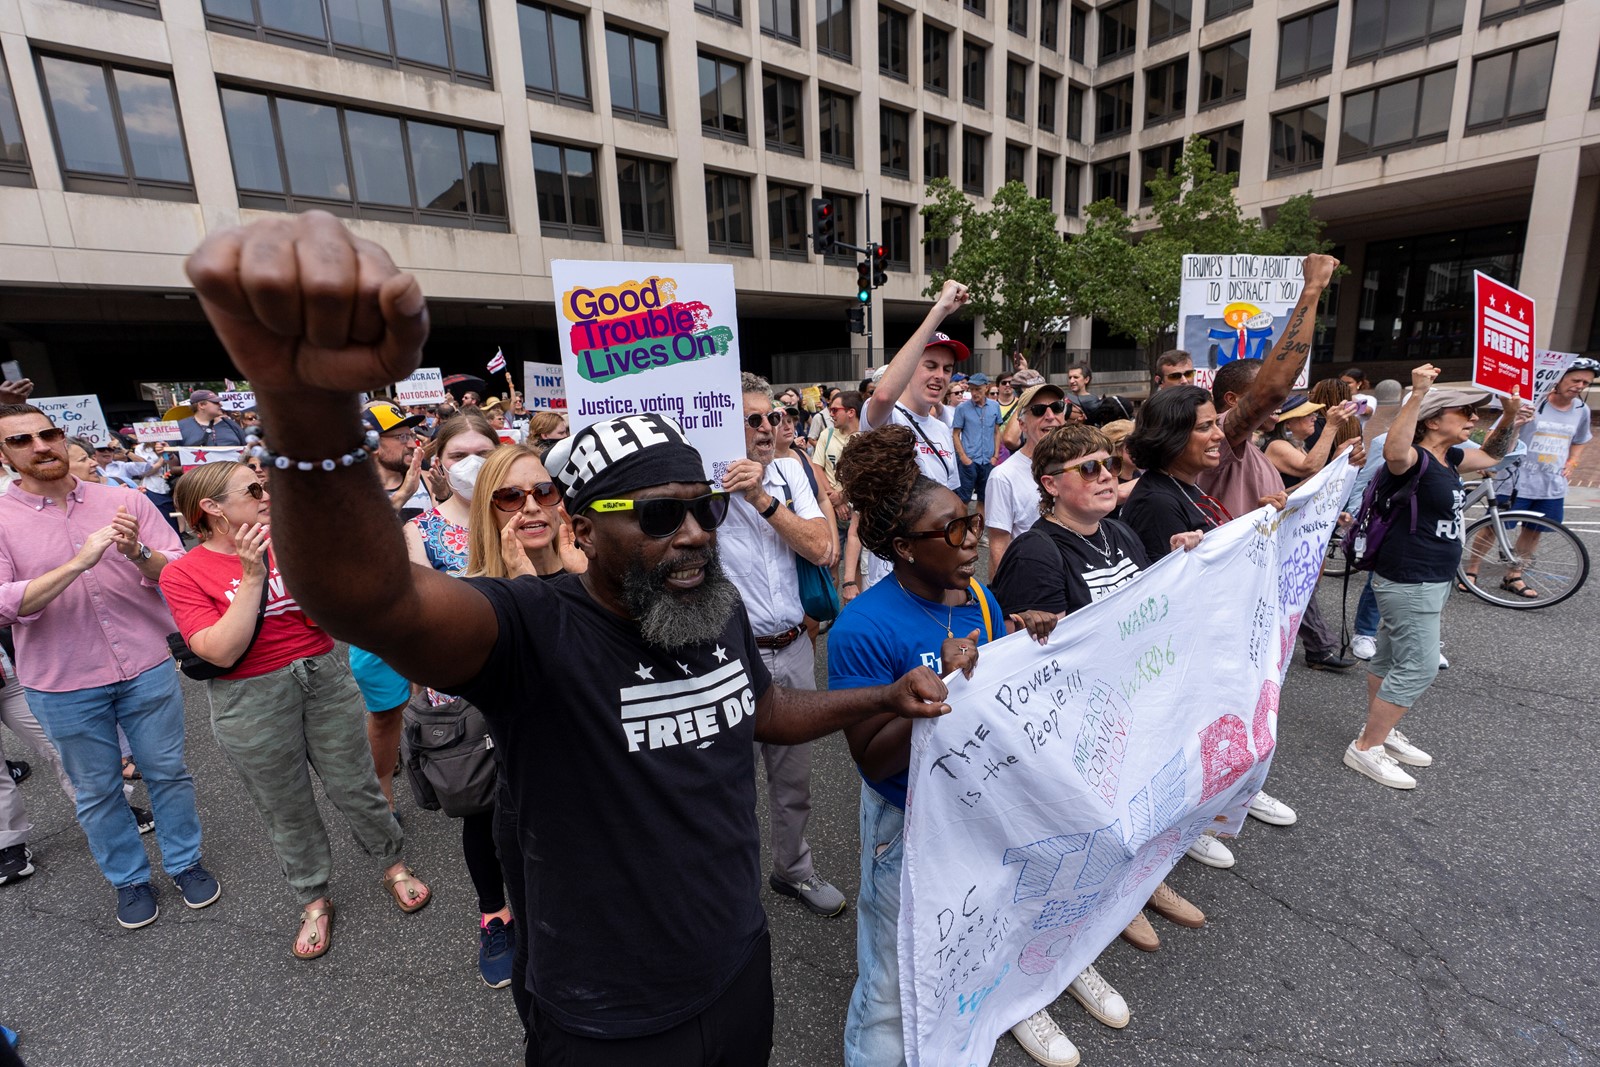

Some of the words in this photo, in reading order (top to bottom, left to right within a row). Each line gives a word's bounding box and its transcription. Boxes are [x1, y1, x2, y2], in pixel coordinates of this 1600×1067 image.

[1187, 256, 1223, 277] TRUMP'S
[1229, 256, 1259, 278] LYING
[1261, 258, 1290, 278] ABOUT
[570, 279, 661, 320] Good
[1209, 281, 1221, 302] TO
[1228, 281, 1271, 301] DISTRACT
[1280, 281, 1299, 300] YOU
[575, 306, 694, 348] Trouble
[1483, 327, 1514, 357] FREE
[1514, 340, 1530, 363] DC
[584, 342, 670, 379] Lives
[672, 333, 717, 361] On
[400, 390, 444, 400] AUTOCRACY
[534, 375, 562, 387] TINY
[39, 402, 68, 412] home
[76, 399, 92, 409] of
[578, 396, 638, 416] Justice,
[640, 393, 684, 416] voting
[693, 391, 736, 412] rights,
[702, 411, 723, 428] all!
[77, 420, 99, 435] pick
[1165, 633, 1175, 666] 6
[622, 706, 720, 753] FREE
[722, 688, 756, 729] DC
[1073, 685, 1107, 776] IMPEACH
[1087, 691, 1117, 788] CONVICT
[1100, 712, 1131, 805] REMOVE
[957, 790, 982, 808] is
[983, 755, 1019, 781] the
[937, 885, 980, 942] DC
